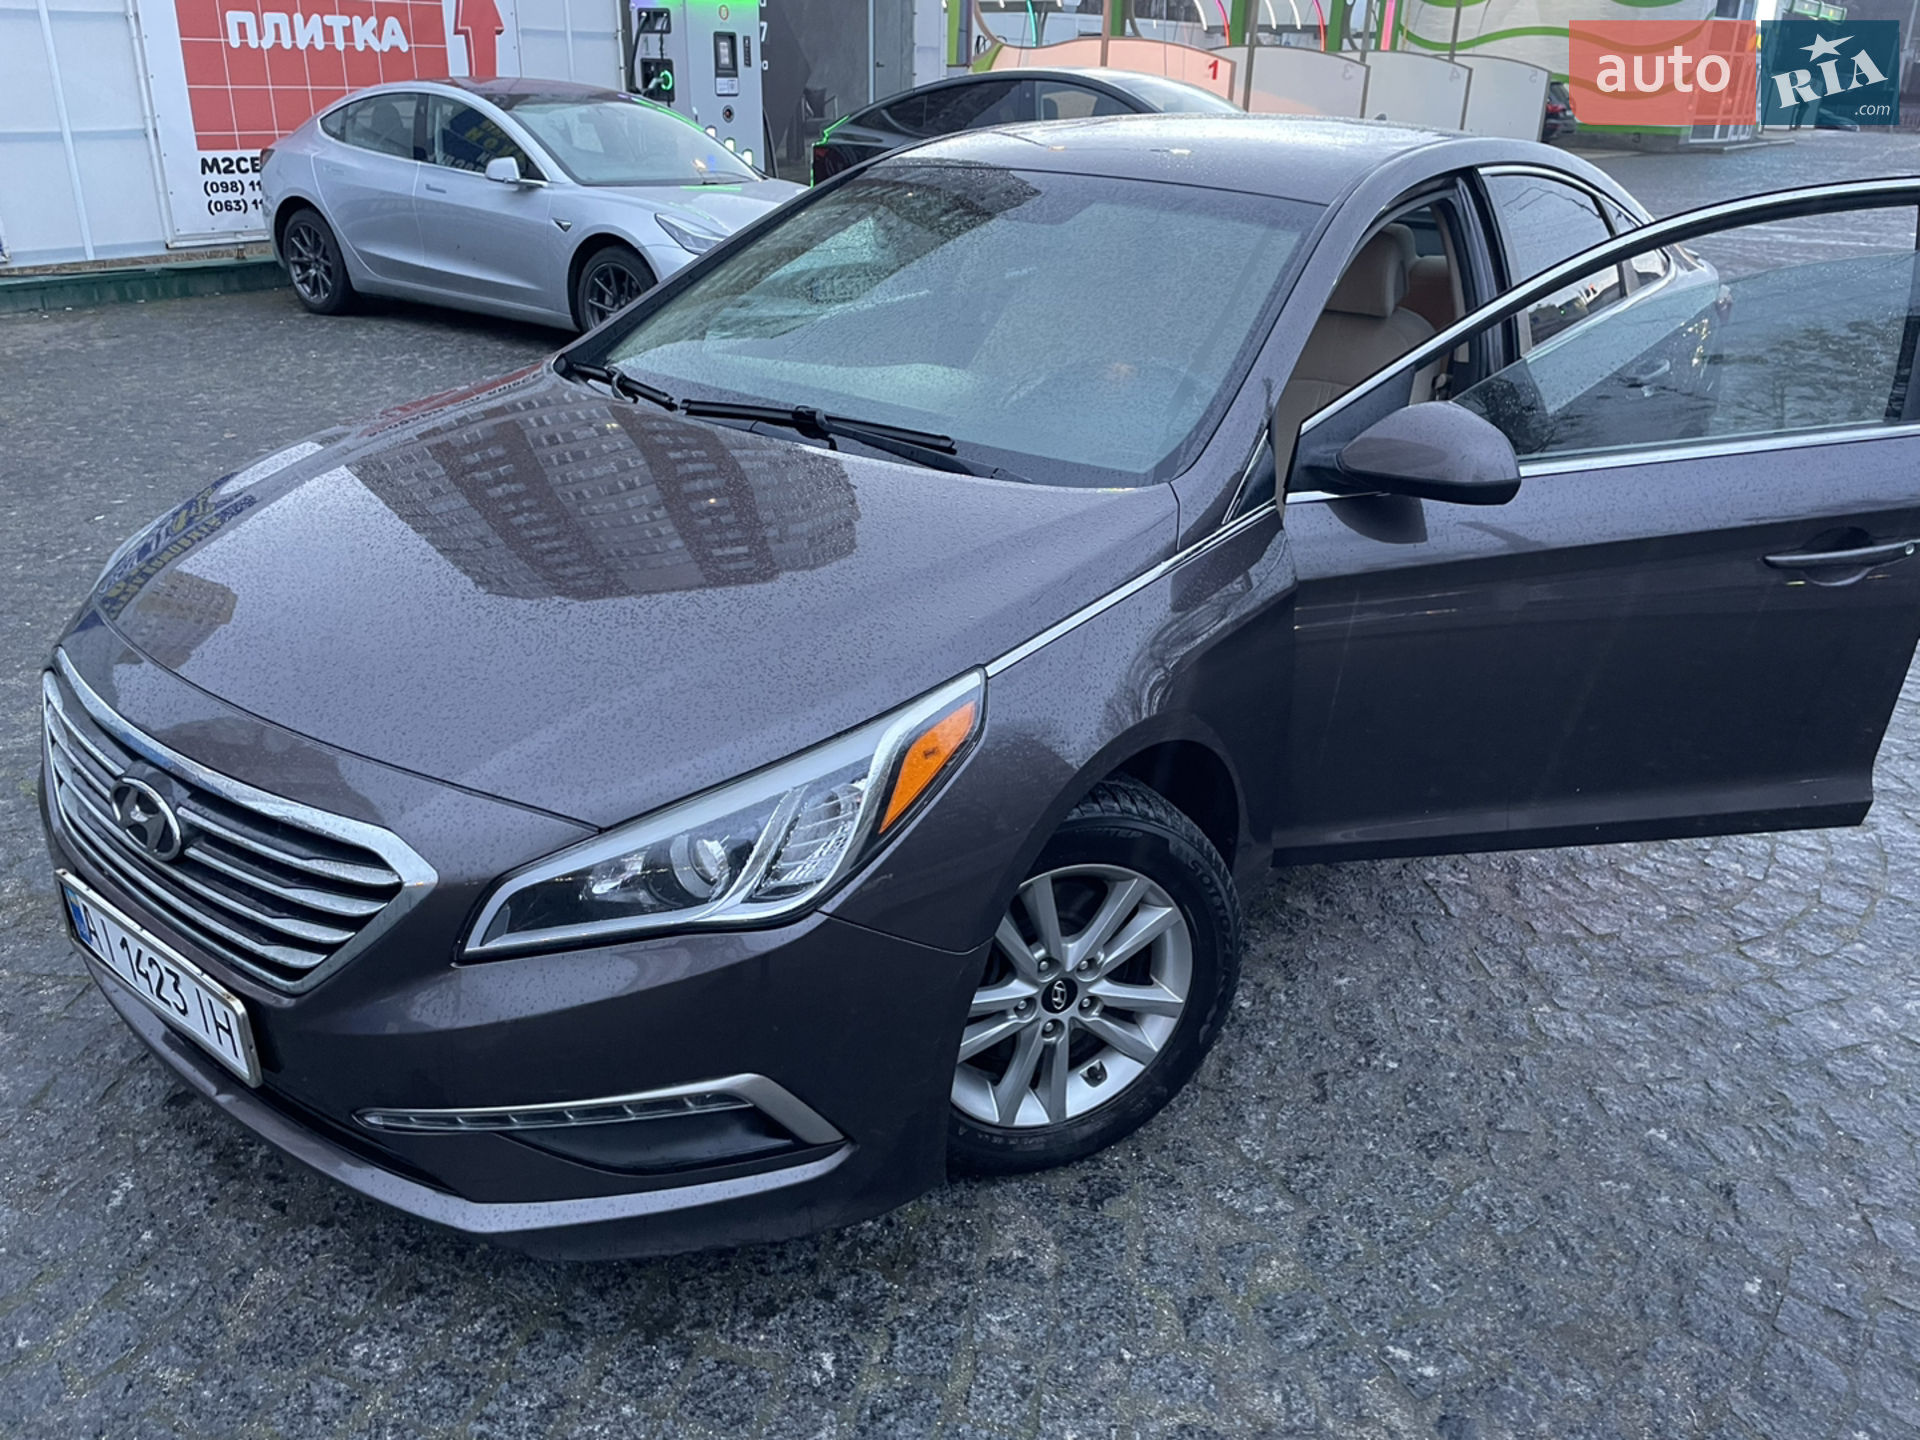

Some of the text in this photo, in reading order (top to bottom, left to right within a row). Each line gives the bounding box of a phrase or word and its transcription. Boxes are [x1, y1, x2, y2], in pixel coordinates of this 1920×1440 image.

[225, 10, 409, 52] ПЛИТКА
[1208, 59, 1219, 80] 1
[204, 180, 245, 197] (098)
[208, 198, 248, 216] (063)
[82, 902, 239, 1060] AI 1423 IH
